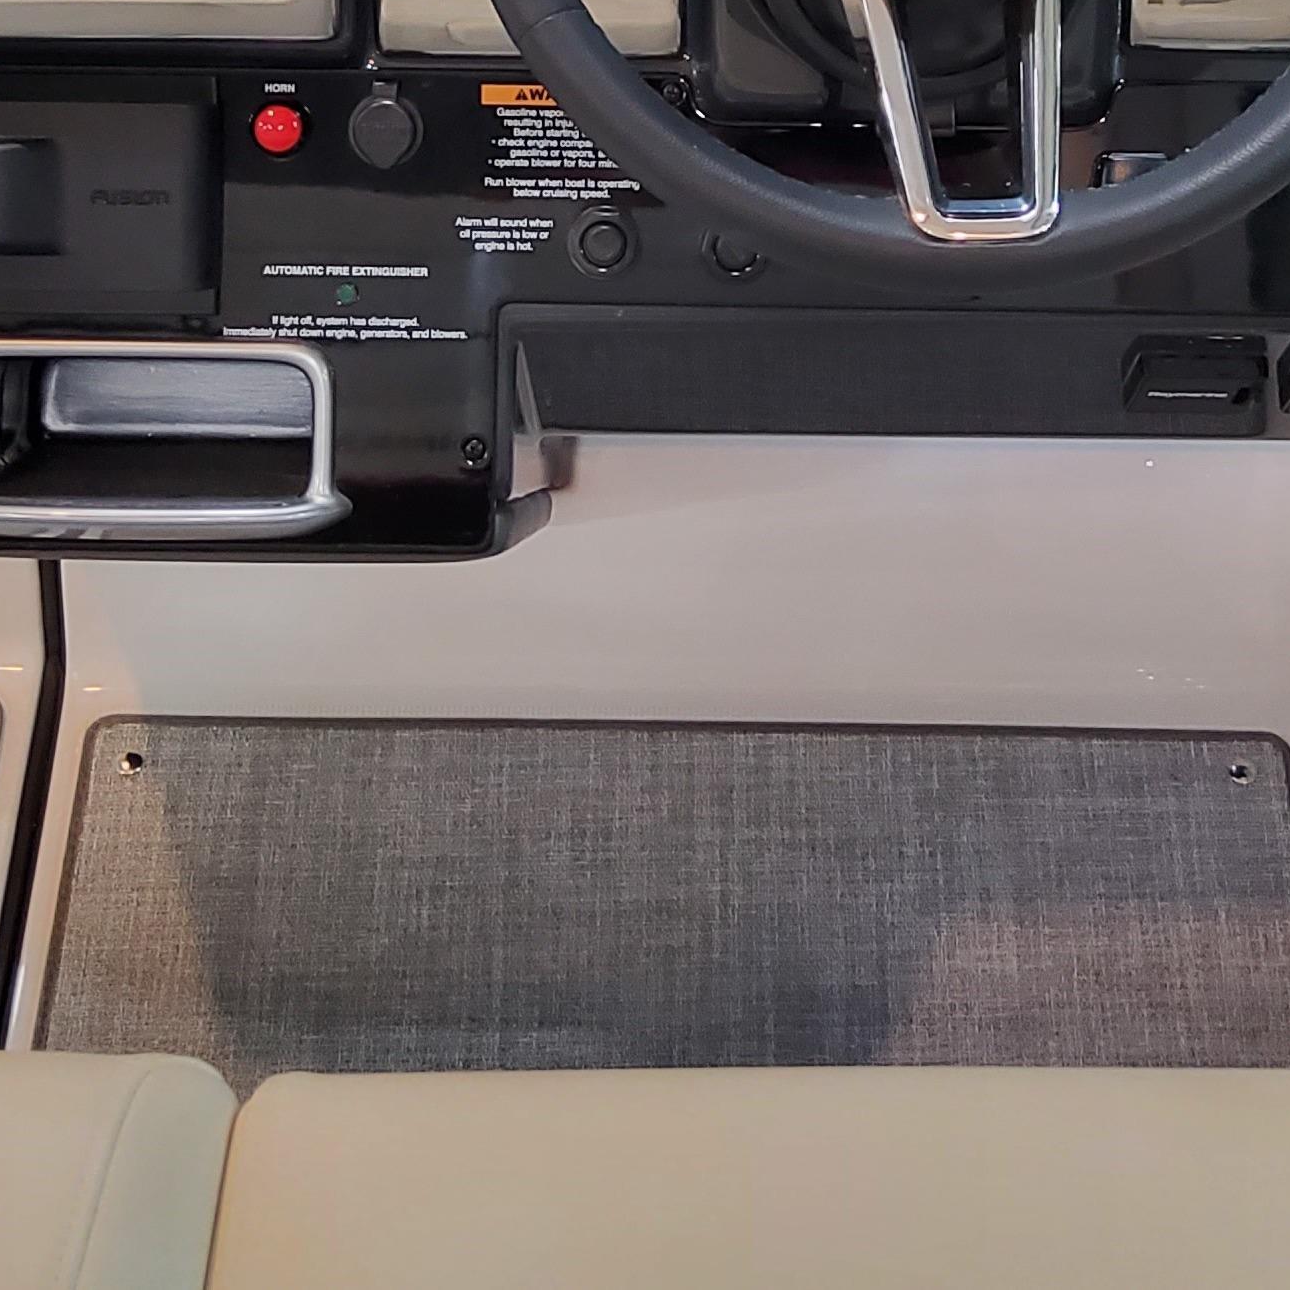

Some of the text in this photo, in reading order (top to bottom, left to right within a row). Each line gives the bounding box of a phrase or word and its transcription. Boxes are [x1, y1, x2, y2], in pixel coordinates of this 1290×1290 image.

[264, 83, 295, 93] HORN
[496, 107, 537, 117] Gasoline
[504, 118, 542, 128] resulting
[545, 119, 553, 127] in
[513, 128, 544, 137] Before
[546, 128, 580, 139] starting
[498, 138, 525, 147] check
[527, 139, 558, 148] engine
[510, 149, 548, 158] gasoline
[562, 150, 595, 159] vapors,
[494, 159, 529, 168] operate
[531, 159, 561, 167] blower
[564, 159, 576, 167] for
[578, 159, 596, 168] four
[484, 177, 640, 191] Run blower when boat is operating
[90, 189, 170, 205] FUSION
[513, 188, 611, 199] below cruising speed.
[455, 217, 554, 228] Alarm will sound when
[459, 229, 549, 240] oil pressure is low or
[474, 241, 533, 252] engine is hot.
[263, 265, 428, 277] AUTOMATIC FIRE EXTINGUISHER
[272, 315, 419, 328] If light off, system has discharged.
[223, 326, 468, 339] Immediately shut down engine, generators, and blowers.
